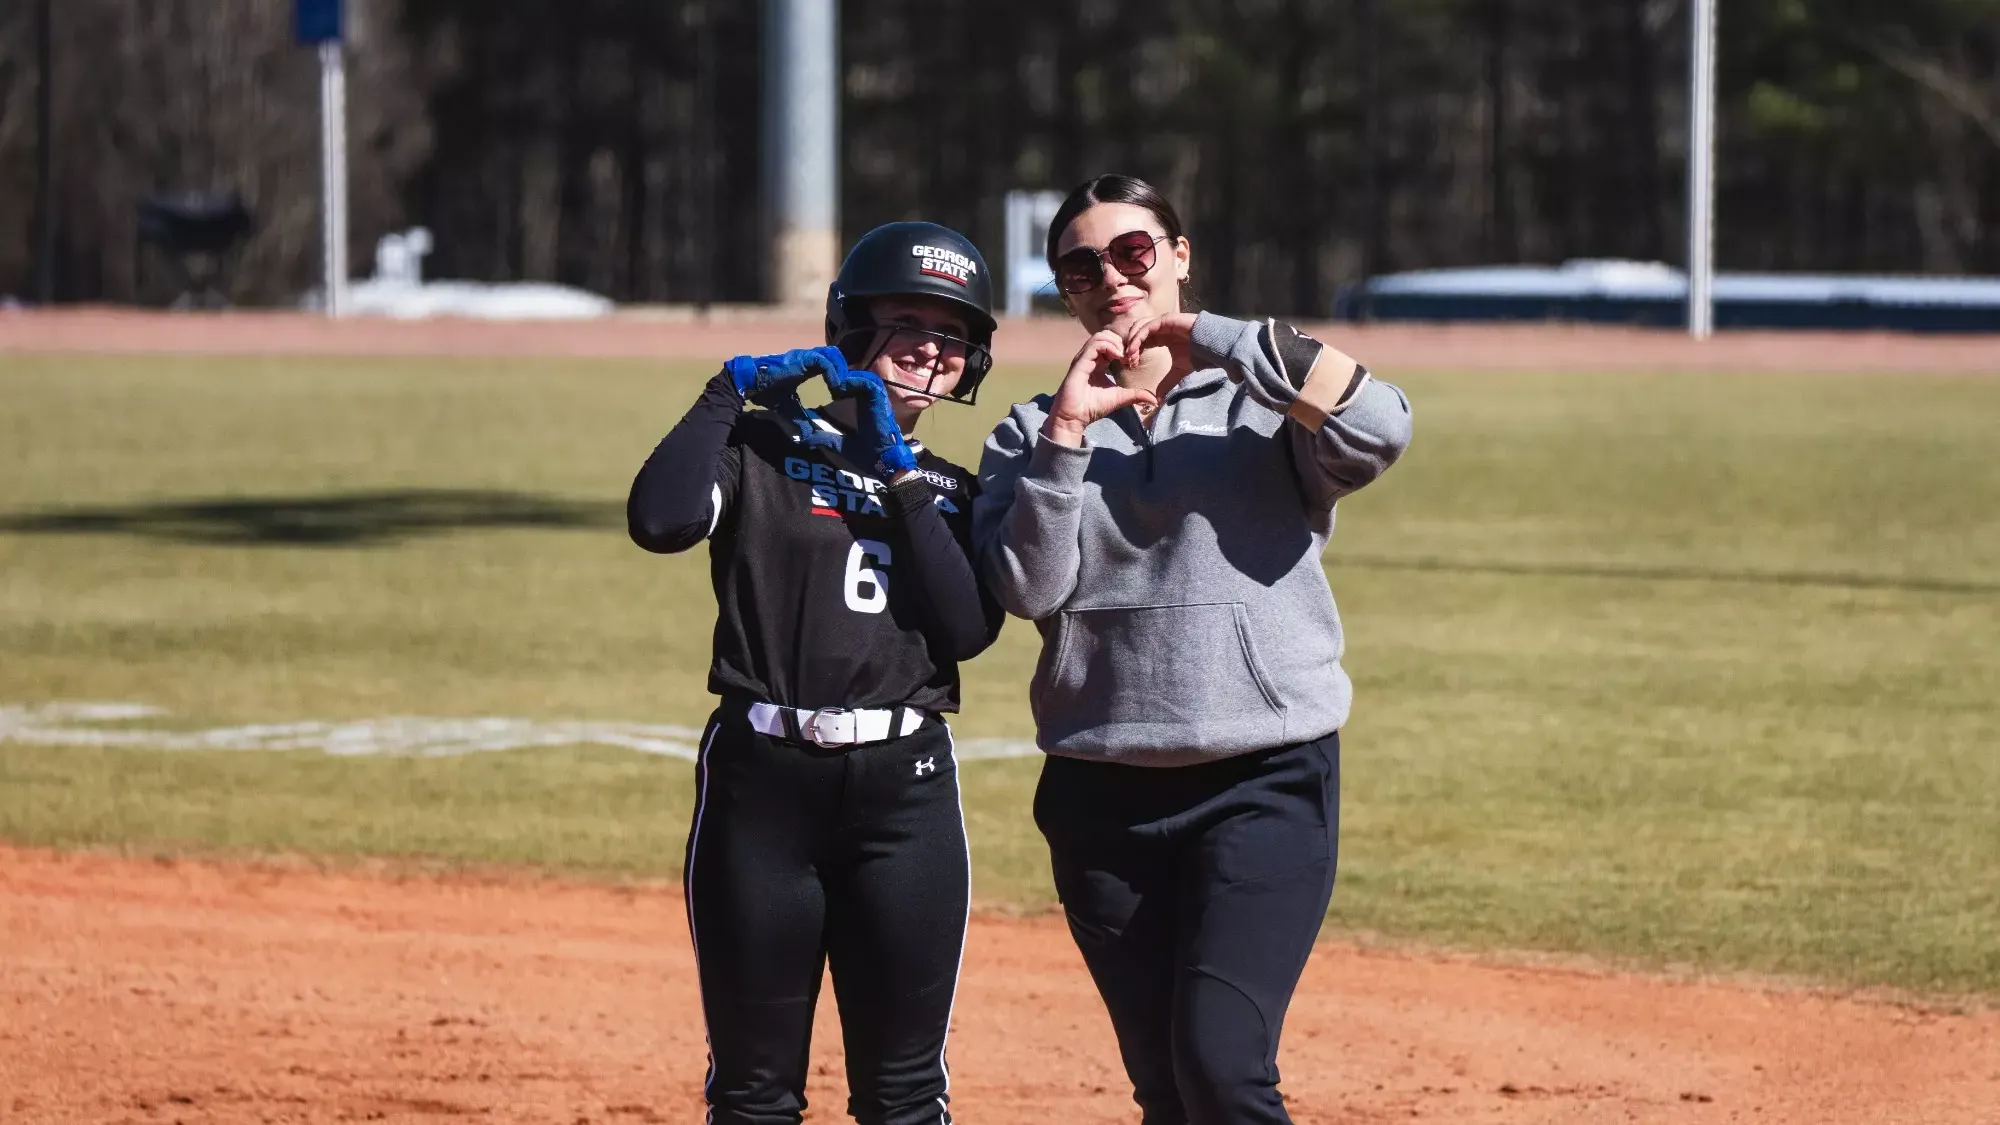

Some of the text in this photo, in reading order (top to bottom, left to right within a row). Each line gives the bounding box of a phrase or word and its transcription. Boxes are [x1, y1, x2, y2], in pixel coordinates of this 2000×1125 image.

[912, 245, 977, 275] GEORGIA
[921, 257, 969, 281] STATE
[1177, 420, 1230, 434] Panther
[784, 456, 960, 513] GEORA
[811, 484, 887, 517] STA
[844, 538, 892, 614] 6
